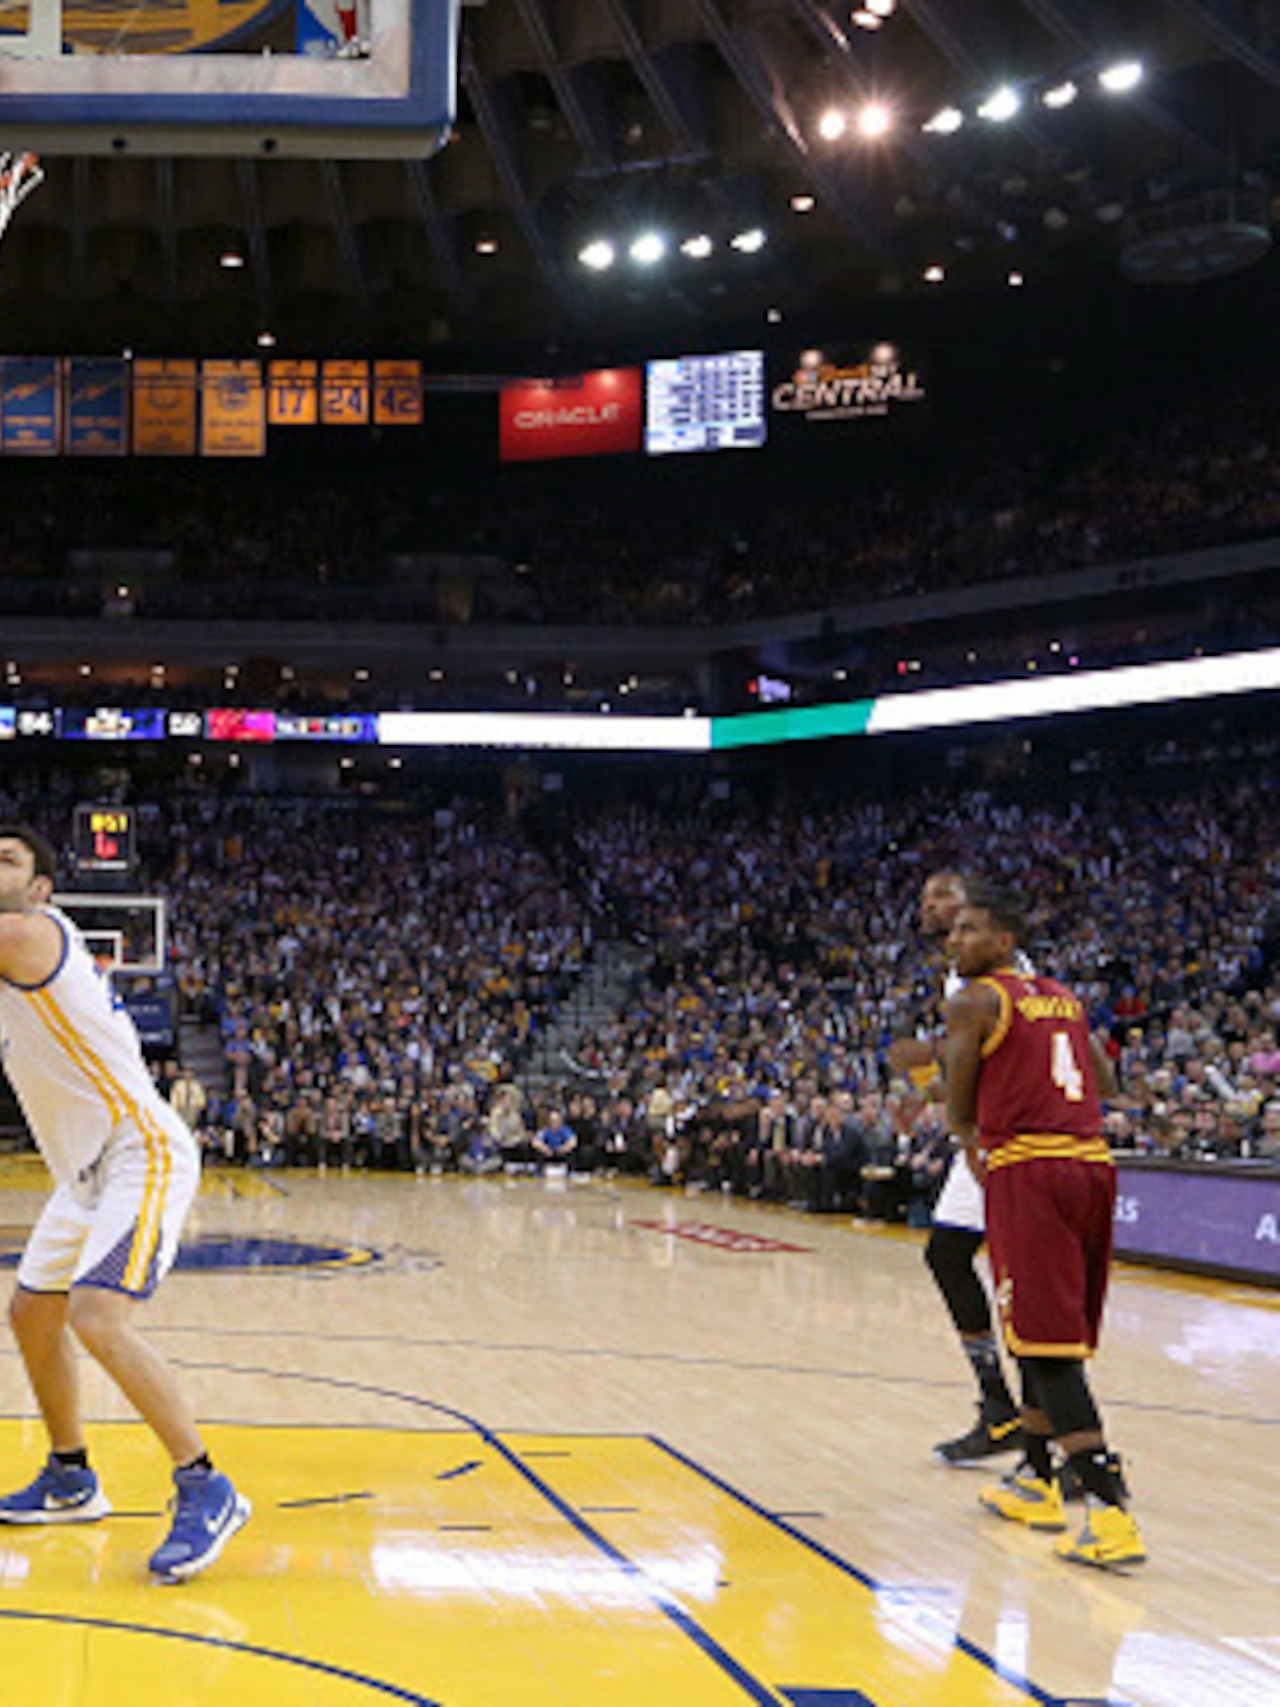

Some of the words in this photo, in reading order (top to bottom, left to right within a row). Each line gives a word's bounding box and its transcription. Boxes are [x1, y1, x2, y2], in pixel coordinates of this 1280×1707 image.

[277, 386, 307, 416] 17
[326, 386, 363, 416] 24
[381, 386, 420, 416] 42
[773, 371, 925, 411] CENTRAL
[512, 402, 619, 430] ORACLE
[1050, 1031, 1084, 1101] 4
